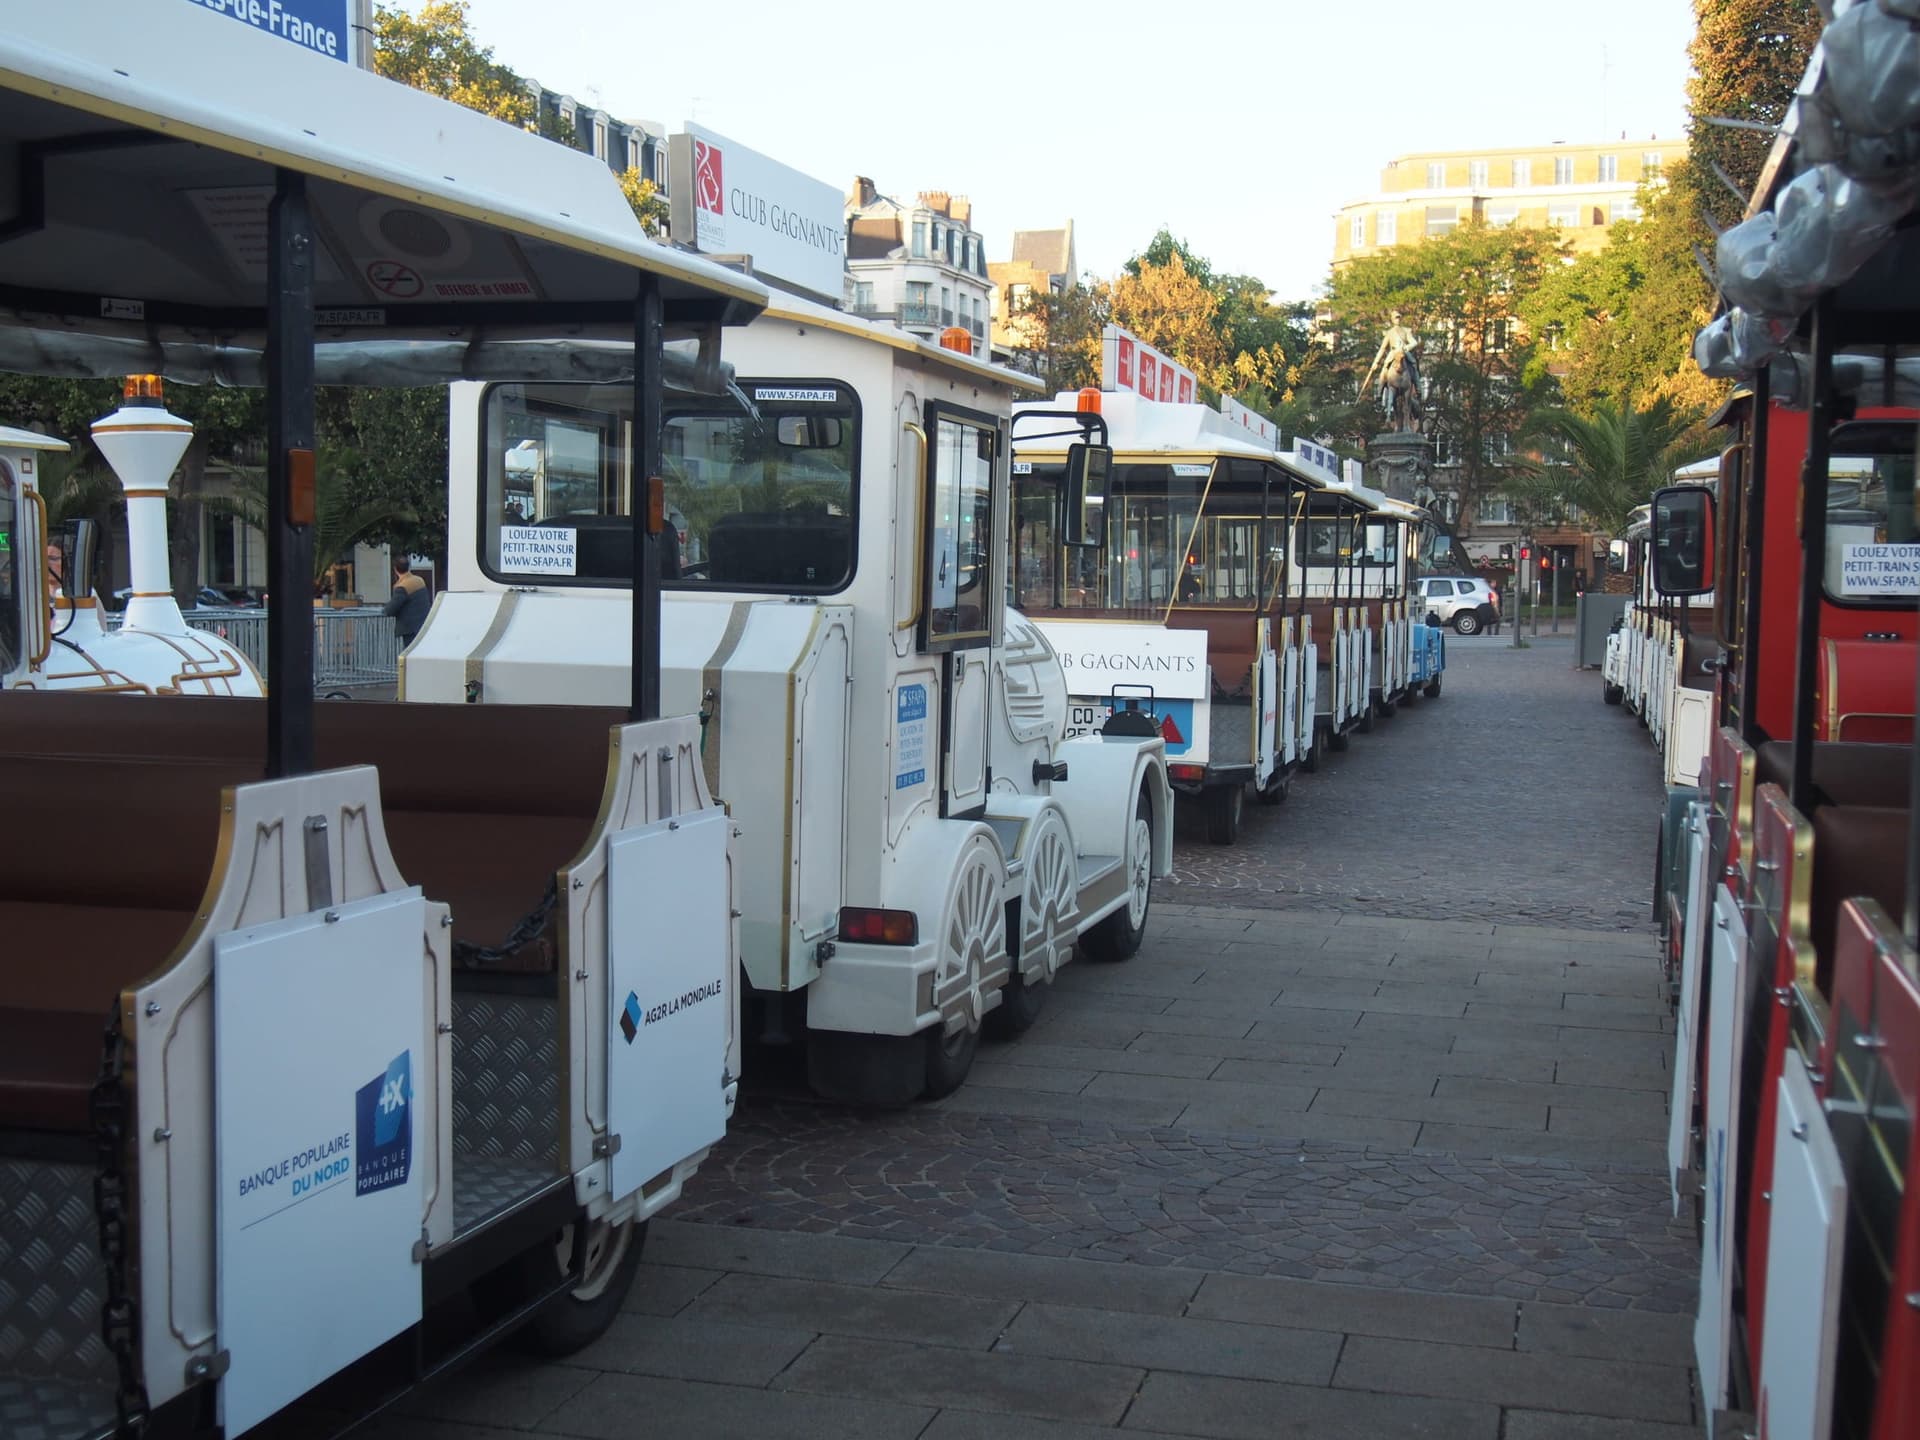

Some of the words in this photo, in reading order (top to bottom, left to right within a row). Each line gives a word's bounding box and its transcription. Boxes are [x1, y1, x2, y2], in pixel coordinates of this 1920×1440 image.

[731, 187, 767, 226] CLUB
[771, 204, 839, 256] GAGNANTS
[757, 391, 835, 401] WWW.SFAPA.FR
[509, 529, 538, 540] LOUEZ
[539, 530, 568, 541] VOTRE
[503, 543, 555, 553] PETIT-TRAIN
[557, 544, 575, 554] SUR
[1852, 546, 1889, 558] LOUEZ
[504, 556, 572, 568] WWW.SFAPA.FR
[1844, 561, 1910, 572] PETIT-TRAIN
[1080, 653, 1196, 673] GAGNANTS
[644, 1003, 667, 1027] AG2R
[668, 1000, 680, 1015] LA
[680, 979, 722, 1010] MONDIALE
[239, 1160, 290, 1197] BANQUE
[292, 1132, 350, 1173] POPULAIRE
[358, 1148, 406, 1175] BANQUE
[292, 1174, 312, 1196] DU
[314, 1157, 350, 1187] NORD
[358, 1166, 406, 1191] POPULAIRE
